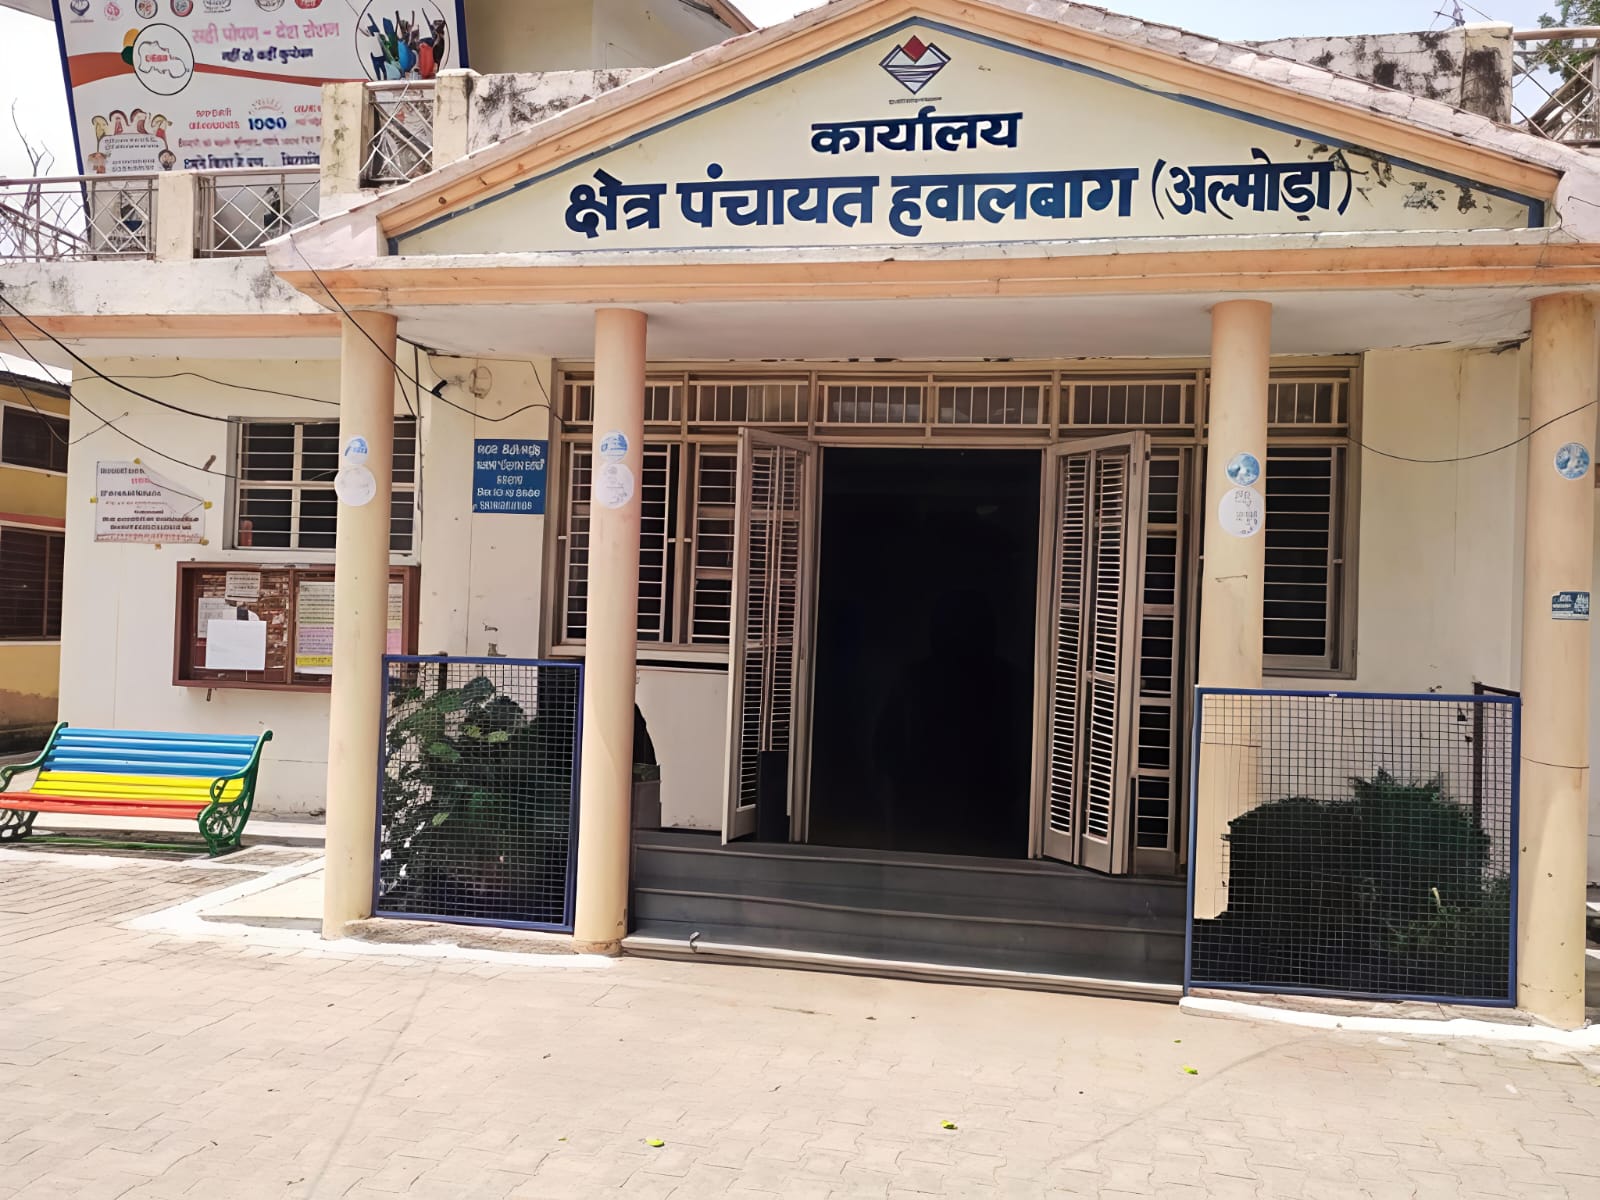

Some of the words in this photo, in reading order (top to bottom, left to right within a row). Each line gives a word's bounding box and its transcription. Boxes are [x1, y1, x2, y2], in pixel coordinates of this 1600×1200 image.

[811, 105, 1023, 154] कार्यालय
[565, 168, 667, 238] क्षेत्र
[676, 162, 879, 228] पंचायत
[889, 167, 1139, 237] हवालबाग
[1152, 148, 1352, 221] (अल्मोड़ा)
